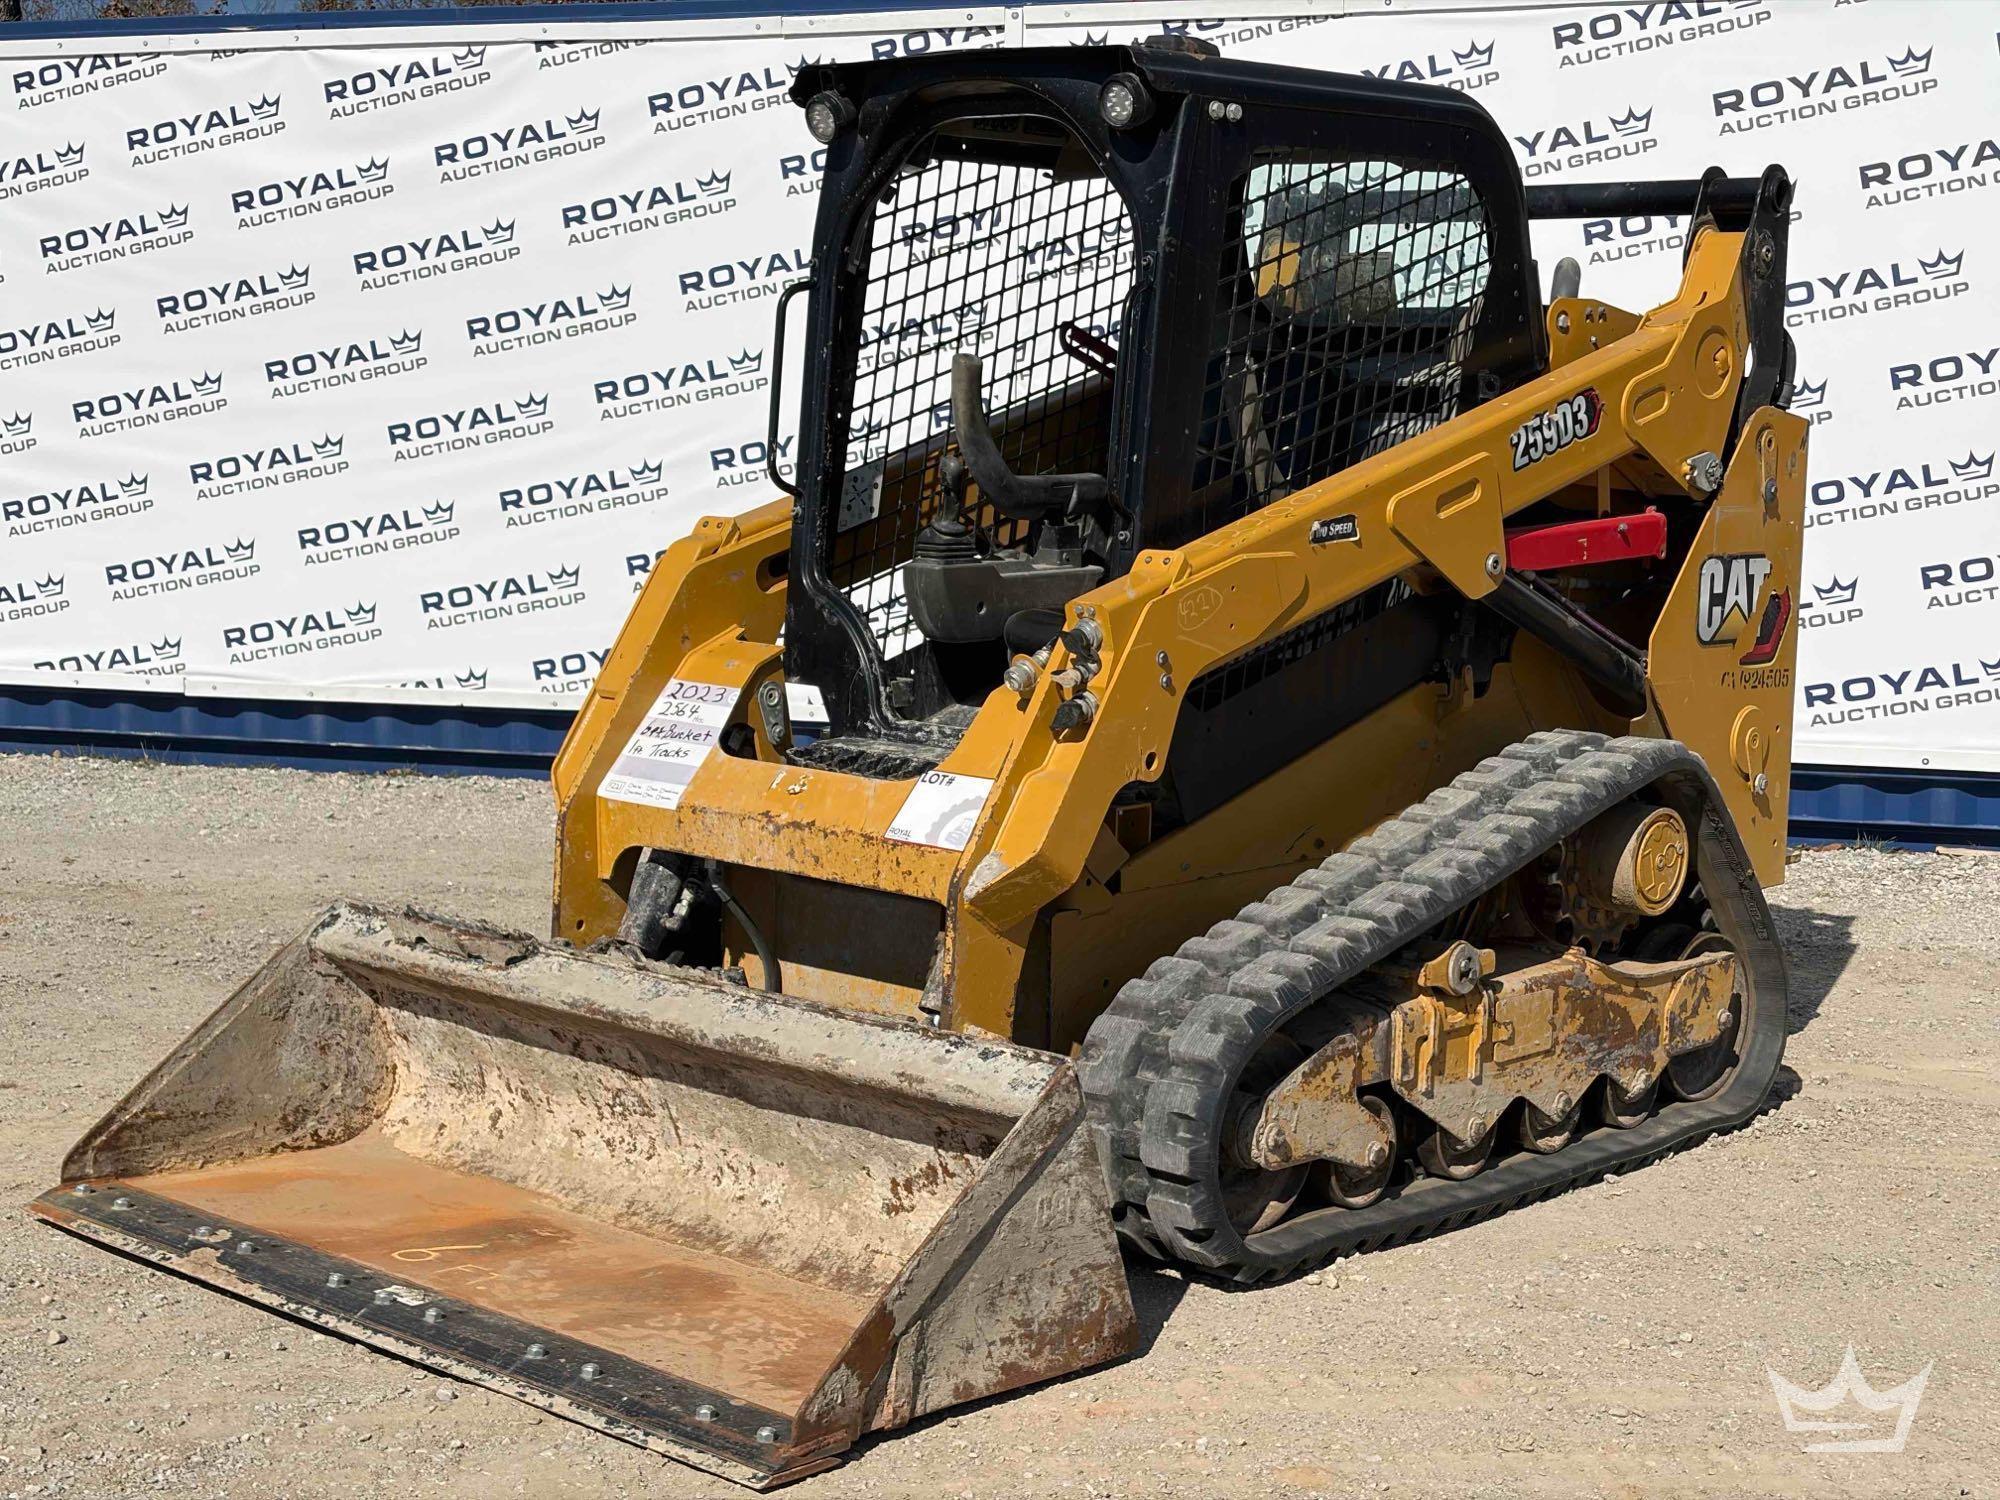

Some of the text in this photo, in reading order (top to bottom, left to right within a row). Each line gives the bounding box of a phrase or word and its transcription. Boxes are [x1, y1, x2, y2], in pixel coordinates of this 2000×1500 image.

[1559, 10, 1772, 69] AUCTION GROUP
[18, 62, 168, 110] AUCTION GROUP
[323, 57, 453, 104] ROYAL
[329, 71, 491, 121] AUCTION GROUP
[647, 67, 786, 118] ROYAL
[1712, 61, 1888, 117] ROYAL
[126, 105, 250, 152] ROYAL
[653, 102, 747, 135] AUCTION
[1719, 78, 1938, 137] AUCTION GROUP
[131, 121, 286, 168] AUCTION GROUP
[434, 119, 567, 167] ROYAL
[440, 135, 606, 184] AUCTION GROUP
[1513, 120, 1610, 158] YAL
[1567, 138, 1658, 169] GROUP
[25, 168, 90, 193] GROUP
[1858, 139, 2000, 190] ROYA
[231, 168, 357, 214] ROYAL
[237, 184, 395, 231] AUCTION GROUP
[561, 181, 697, 229] ROYAL
[1865, 173, 1987, 210] AUCTION
[39, 214, 159, 259] ROYAL
[568, 198, 737, 247] AUCTION GROUP
[46, 230, 194, 275] AUCTION GROUP
[353, 229, 483, 275] ROYAL
[360, 246, 521, 292] AUCTION GROUP
[1588, 234, 1688, 266] AUCTIO
[156, 274, 280, 319] ROYAL
[685, 282, 778, 313] AUCTION
[1784, 262, 1919, 307] OYAL
[1786, 281, 1970, 328] CTION GROUP
[163, 291, 316, 335] AUCTION GROUP
[466, 295, 599, 341] ROYAL
[0, 318, 87, 353] OYAL
[0, 334, 121, 371] CTION GROUP
[473, 312, 637, 358] AUCTION GROUP
[264, 339, 391, 383] ROYAL
[271, 356, 428, 399] AUCTION GROUP
[593, 359, 729, 404] ROYAL
[1889, 347, 2000, 391] ROY
[71, 381, 192, 423] ROYAL
[600, 377, 769, 421] AUCTION GROUP
[1896, 380, 2000, 411] AUCTIO
[79, 398, 228, 439] AUCTION GROUP
[387, 403, 516, 446] ROYAL
[1511, 395, 1590, 470] 259D3
[0, 438, 37, 455] OUP
[394, 420, 554, 462] AUCTION GROUP
[709, 435, 794, 472] ROY
[189, 443, 314, 485] ROYAL
[196, 461, 350, 501] AUCTION GROUP
[1811, 463, 1949, 506] OYAL
[1, 482, 120, 522] ROYAL
[499, 470, 630, 512] ROYAL
[506, 487, 669, 529] AUCTION GROUP
[1904, 483, 2000, 511] GROUP
[8, 499, 154, 538] AUCTION GROUP
[297, 509, 424, 550] ROYAL
[105, 547, 226, 586] ROYAL
[304, 527, 460, 566] AUCTION GROUP
[112, 564, 261, 602] AUCTION GROUP
[420, 574, 549, 614] ROYAL
[1697, 557, 1772, 642] CAT
[8, 599, 70, 621] GROUP
[223, 610, 346, 649] ROYAL
[427, 591, 586, 630] AUCTION GROUP
[229, 628, 383, 665] AUCTION GROUP
[666, 682, 727, 703] 2023
[1803, 663, 1980, 708] ROYAL
[1803, 663, 1980, 708] ROYAL
[658, 701, 702, 719] 2564
[1810, 698, 1929, 727] AUCTION
[648, 742, 691, 758] Tracks
[920, 772, 957, 787] LOT#
